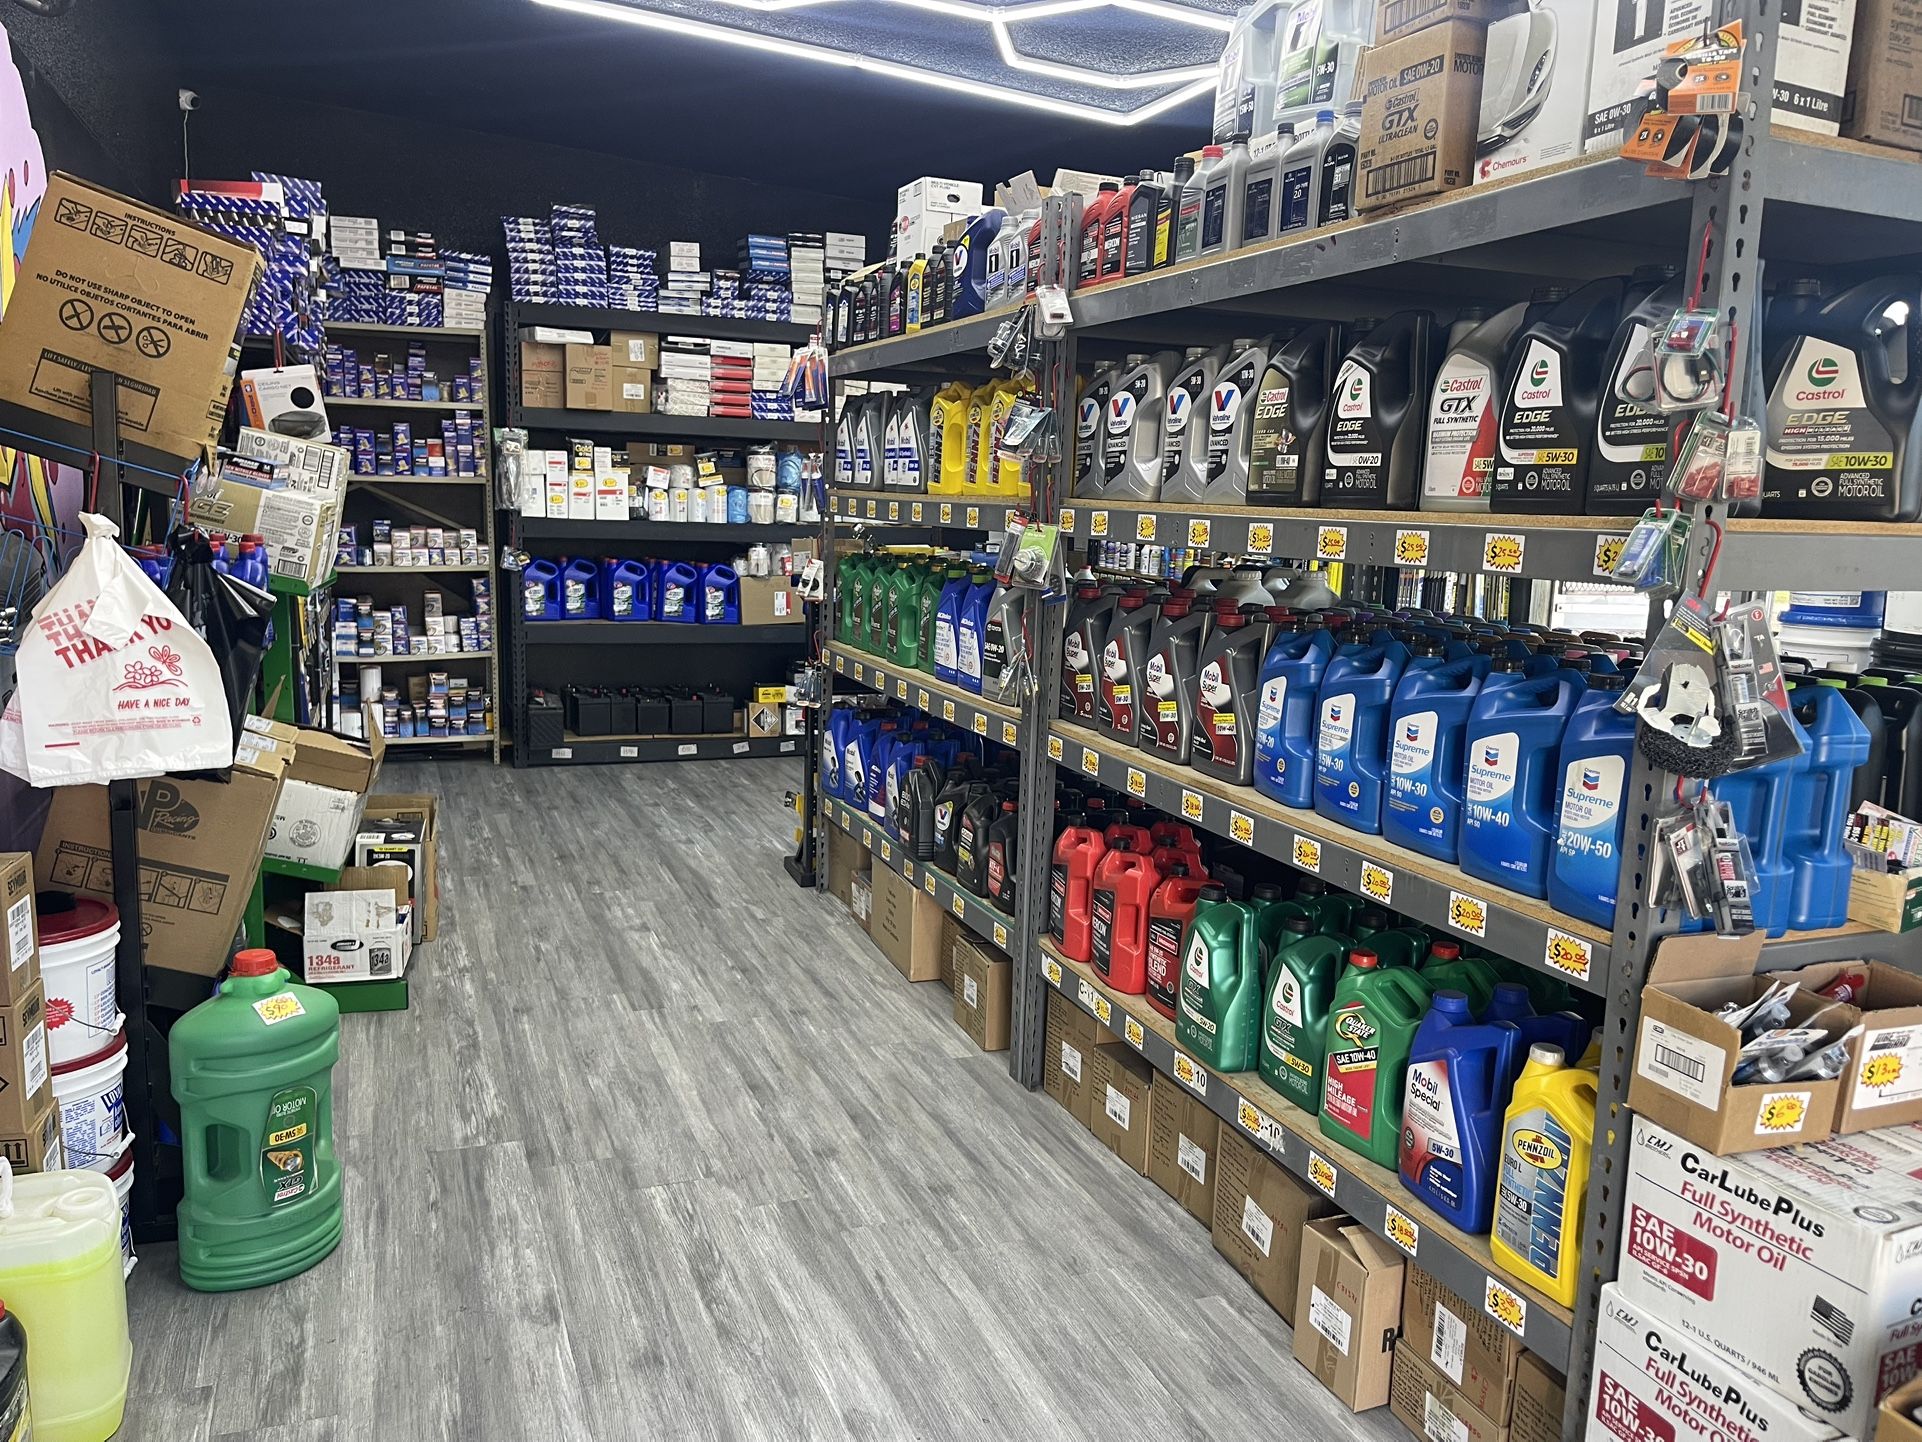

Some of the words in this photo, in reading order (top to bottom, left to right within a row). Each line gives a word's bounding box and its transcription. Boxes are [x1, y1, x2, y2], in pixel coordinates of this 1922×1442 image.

[1316, 61, 1335, 76] 5W-30
[1404, 67, 1416, 83] SAE
[1416, 58, 1440, 78] 0W-20
[1391, 92, 1417, 108] Castrol
[1793, 93, 1799, 105] 6
[1811, 98, 1828, 112] Litre
[1382, 104, 1420, 131] GTX
[1594, 112, 1608, 124] SAE
[1609, 103, 1632, 120] 0W-30
[1378, 124, 1419, 144] ULTRACLEAN
[1492, 155, 1527, 170] Chemours
[124, 212, 176, 237] INSTRUCTIONS
[55, 269, 68, 279] DO
[69, 273, 87, 285] NOT
[87, 280, 103, 292] USE
[102, 286, 130, 301] SHARP
[130, 296, 161, 313] OBJECT
[161, 307, 173, 317] TO
[174, 312, 196, 326] OPEN
[36, 272, 49, 282] NO
[49, 278, 79, 294] UTILICE
[80, 288, 115, 306] OBJETOS
[115, 301, 162, 323] CORTANTES
[161, 320, 184, 332] PARA
[184, 327, 209, 341] ABRIR
[1450, 377, 1483, 392] Castrol
[1266, 389, 1287, 402] Castrol
[1521, 390, 1551, 400] Castrol
[1796, 390, 1846, 402] Castrol
[1255, 404, 1289, 419] EDGE
[1342, 403, 1363, 412] Castrol
[1440, 394, 1480, 415] GTX
[1433, 416, 1445, 424] FULL
[1446, 415, 1479, 424] SYNTHETIC
[1513, 410, 1552, 423] EDGE
[1786, 411, 1850, 426] EDGE
[1336, 420, 1364, 431] EDGE
[1782, 427, 1806, 436] HIGH
[1817, 435, 1839, 443] 15,000
[1358, 456, 1379, 465] 0W-20
[1545, 452, 1574, 463] 5W-30
[1829, 456, 1844, 467] SAE
[1844, 455, 1888, 467] 10W-30
[1355, 479, 1370, 489] MOTOR
[1369, 479, 1377, 489] OIL
[1541, 479, 1560, 490] MOTOR
[1560, 480, 1571, 491] OIL
[1838, 485, 1866, 497] MOTOR
[1866, 485, 1885, 497] OIL
[1852, 479, 1883, 487] SYNTHETIC
[1066, 637, 1081, 650] Mobil
[1066, 648, 1079, 658] Super
[1105, 648, 1118, 661] Mobil
[1104, 659, 1116, 669] Super
[1149, 662, 1164, 674] Mobil
[1148, 673, 1162, 684] Super
[1204, 669, 1219, 682] Mobil
[1202, 682, 1218, 693] Super
[117, 699, 140, 710] HAVE
[144, 699, 150, 708] A
[153, 698, 171, 708] NICE
[174, 697, 191, 707] DAY
[1261, 700, 1281, 715] Supreme
[1321, 719, 1350, 735] Supreme
[1260, 733, 1275, 748] 5W-20
[1395, 740, 1430, 757] Supreme
[1322, 755, 1344, 772] 5W-30
[1471, 764, 1512, 782] Supreme
[1396, 776, 1428, 798] 10W-30
[1469, 777, 1485, 788] MOTOR
[1485, 780, 1494, 790] OIL
[1566, 787, 1614, 809] Supreme
[1473, 804, 1510, 828] 10W-40
[1565, 801, 1583, 813] MOTOR
[1583, 805, 1593, 817] OIL
[154, 811, 200, 830] Racing
[1567, 831, 1612, 859] 20W-50
[1568, 848, 1576, 857] SP
[307, 954, 341, 967] 134a
[371, 952, 390, 966] 134a
[1189, 963, 1204, 979] Castrol
[1276, 1000, 1294, 1016] Castrol
[1200, 1017, 1215, 1031] 5W-20
[1274, 1016, 1292, 1033] GTX
[1345, 1016, 1376, 1035] QUAKER
[1348, 1024, 1370, 1039] STATE
[1336, 1055, 1350, 1064] SAE
[1350, 1050, 1376, 1063] 10W-40
[1290, 1058, 1310, 1073] 5W-30
[1195, 1070, 1206, 1088] 10
[1327, 1075, 1343, 1090] HIGH
[1412, 1068, 1439, 1095] Mobil
[1327, 1084, 1356, 1106] MILEAGE
[1410, 1083, 1442, 1112] Special
[282, 1097, 307, 1112] MOTOR
[274, 1130, 297, 1143] 5W-30
[1646, 1134, 1673, 1152] CMJ
[1431, 1142, 1454, 1159] 5W-30
[1517, 1139, 1555, 1159] PENNZOIL
[1504, 1153, 1517, 1170] EURO
[1506, 1190, 1527, 1212] 5W-30
[1680, 1152, 1826, 1238] CarLubePlus
[1634, 1208, 1676, 1244] SAE
[1680, 1180, 1715, 1210] Full
[1718, 1199, 1814, 1261] Synthetic
[1693, 1211, 1755, 1255] Motor
[1757, 1245, 1788, 1272] Oil
[1633, 1227, 1709, 1281] 10W-30
[1633, 1244, 1643, 1253] API
[1643, 1248, 1670, 1270] SERVICE
[1633, 1251, 1651, 1265] ILSAC
[1615, 1308, 1639, 1328] CMJ
[1681, 1319, 1697, 1334] 12-1
[1698, 1329, 1713, 1344] U.S.
[1714, 1338, 1746, 1363] QUARTS
[1751, 1362, 1767, 1377] 946
[1768, 1371, 1782, 1384] ML
[1884, 1344, 1917, 1367] SAE
[1645, 1356, 1677, 1388] Full
[1807, 1367, 1842, 1391] GASOLINE
[1818, 1365, 1833, 1378] FOR
[1645, 1330, 1770, 1432] CarLubePlus
[1808, 1376, 1839, 1397] ENGINES
[1604, 1376, 1640, 1416] SAE
[1654, 1388, 1708, 1435] Motor
